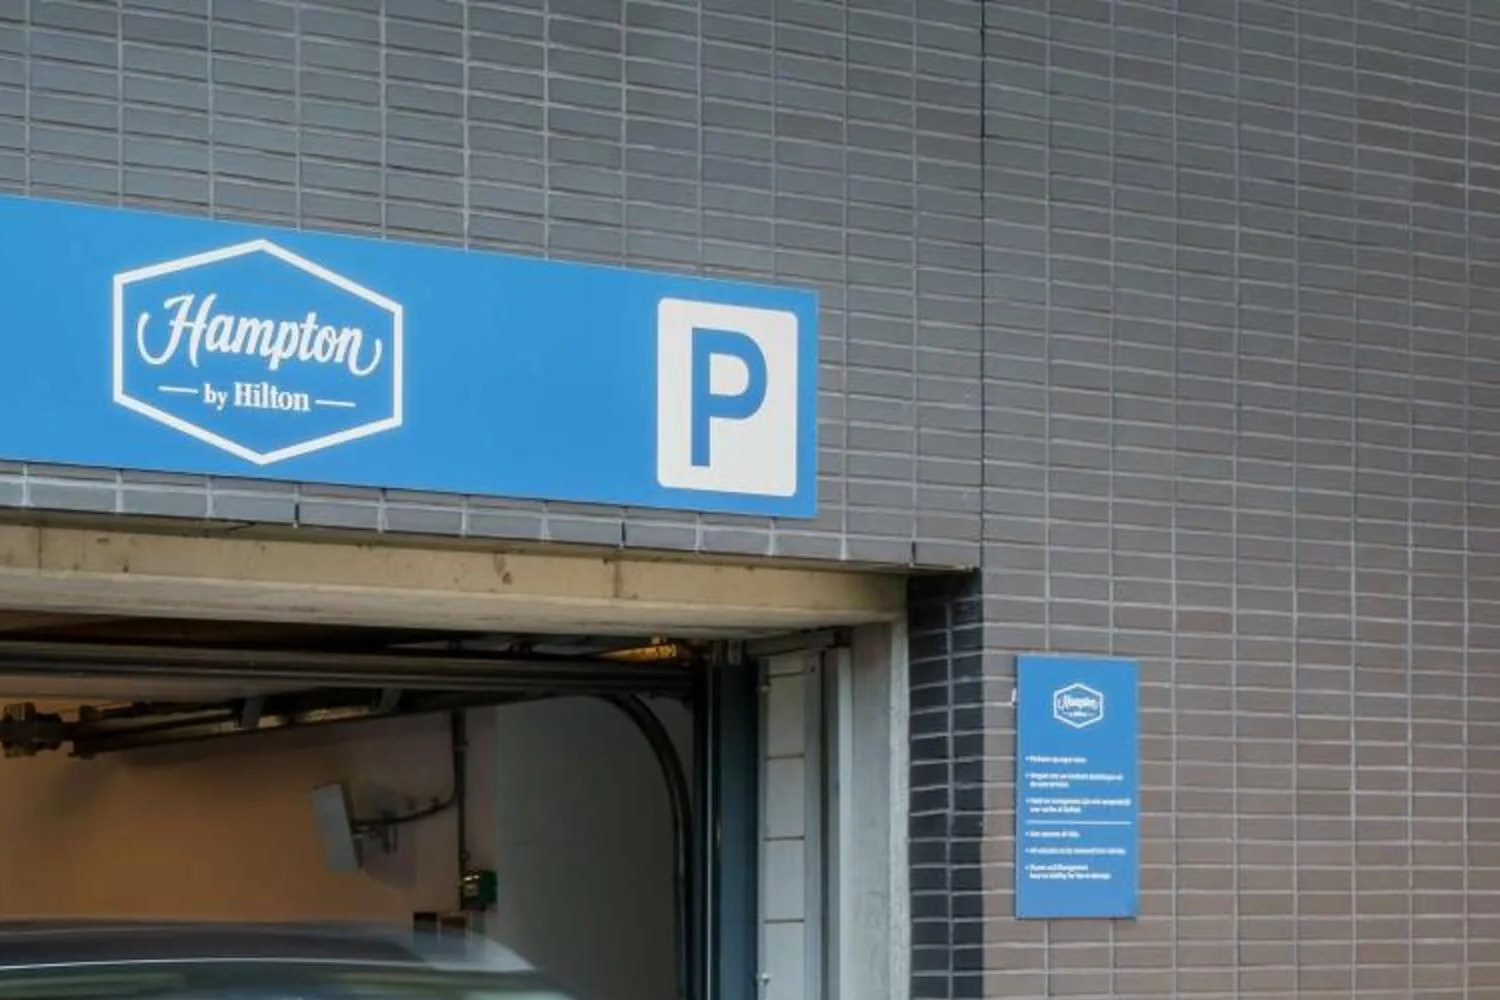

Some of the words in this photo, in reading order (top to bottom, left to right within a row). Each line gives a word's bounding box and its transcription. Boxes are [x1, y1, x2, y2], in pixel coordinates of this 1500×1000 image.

[137, 293, 383, 376] Hampton
[203, 383, 228, 411] by
[233, 381, 311, 413] Hilton
[691, 327, 767, 467] P
